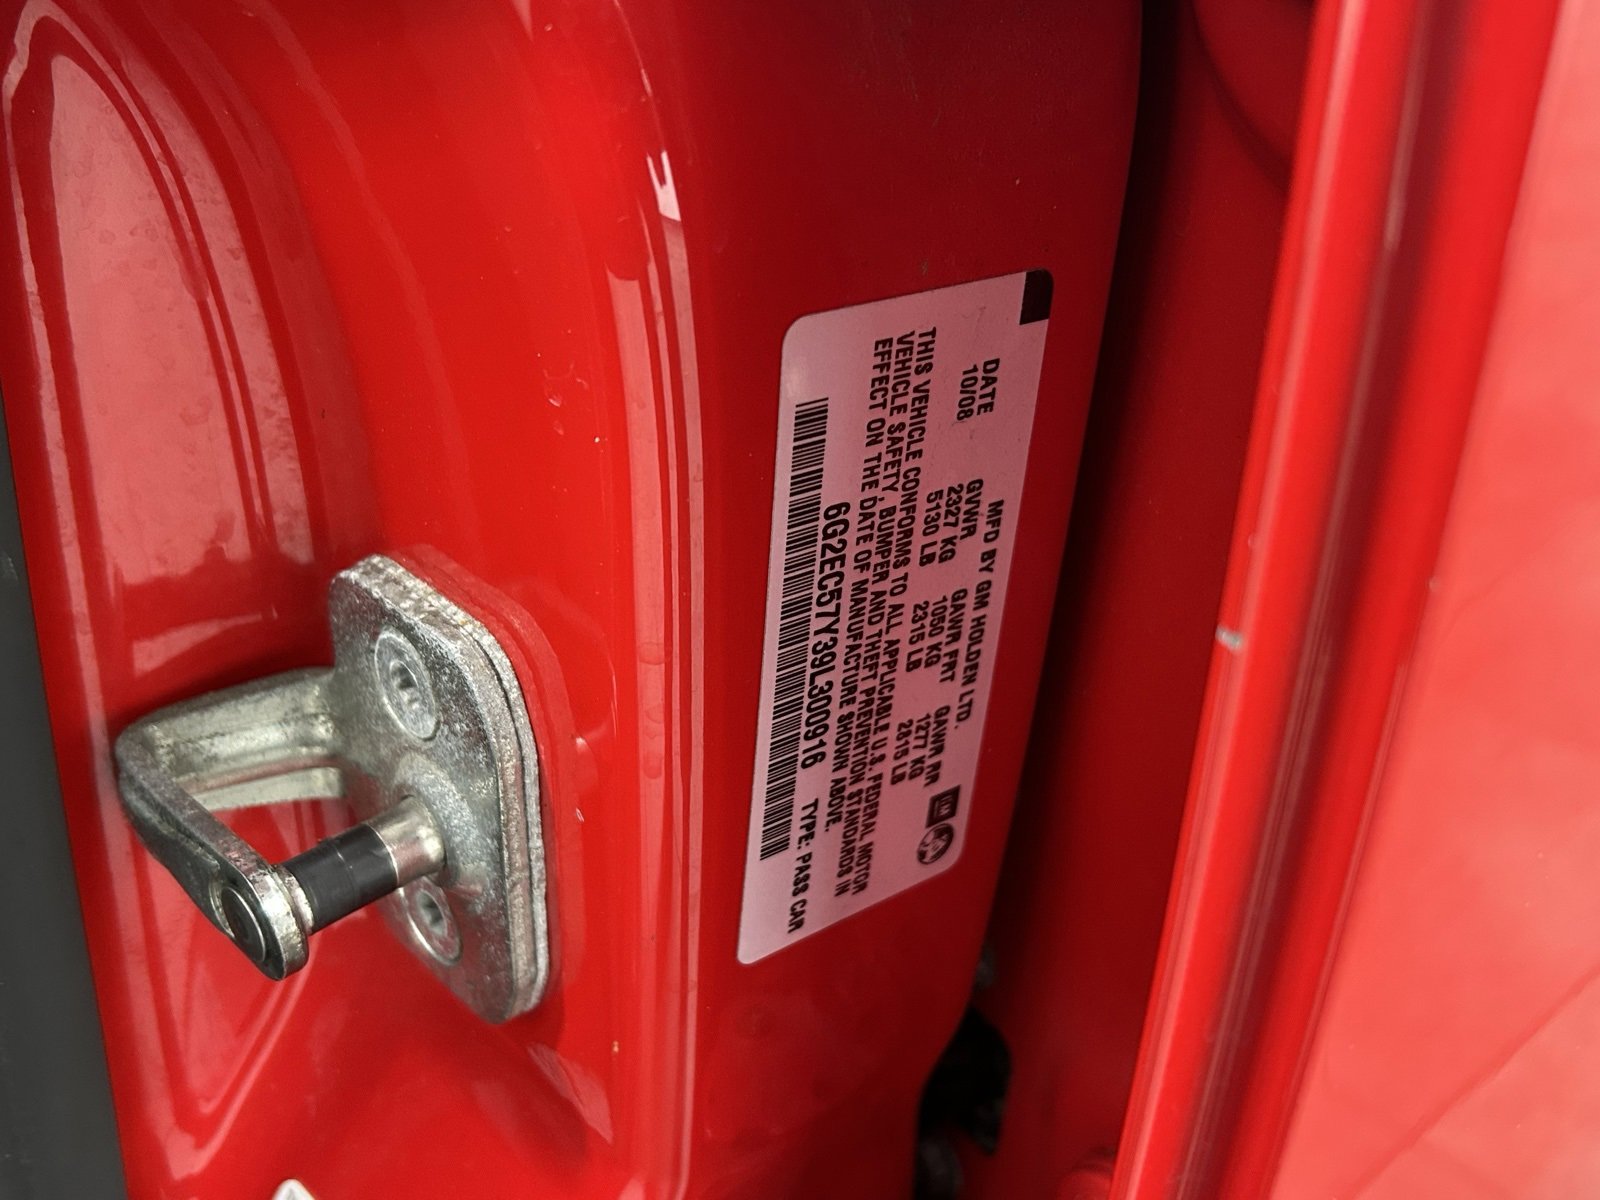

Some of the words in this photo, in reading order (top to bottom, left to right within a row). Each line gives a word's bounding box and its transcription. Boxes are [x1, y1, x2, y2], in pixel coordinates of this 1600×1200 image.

[868, 338, 893, 409] EFFECT
[889, 331, 915, 416] VEHICLE
[913, 327, 936, 375] THIS
[956, 365, 978, 420] 10/08
[976, 358, 1000, 415] DATE
[865, 418, 885, 447] ON
[904, 380, 930, 462] VEHICLE
[860, 452, 882, 492] THE
[876, 422, 906, 501] SAFETY,
[855, 496, 877, 546] DATE
[892, 467, 921, 569] CONFORMS
[921, 489, 944, 536] 5130
[942, 484, 964, 527] 2327
[959, 479, 983, 540] GVWR
[983, 500, 1004, 543] MFD
[853, 550, 872, 573] OF
[871, 506, 896, 584] BUMPER
[918, 541, 937, 567] LB
[938, 535, 958, 563] KG
[978, 549, 996, 572] BY
[888, 573, 908, 596] TO
[972, 580, 992, 611] GM
[867, 590, 887, 625] AND
[884, 604, 904, 635] ALL
[908, 601, 929, 645] 2315
[927, 596, 948, 637] 1050
[944, 589, 968, 646] GAWR
[800, 502, 851, 769] 6G2EC57Y39L300916
[838, 579, 869, 709] MANUFACTURE
[860, 629, 883, 681] THEFT
[923, 642, 942, 668] KG
[961, 615, 986, 686] HOLDEN
[905, 648, 923, 672] LB
[939, 649, 959, 682] FRT
[872, 639, 900, 735] APPLICABLE
[954, 689, 974, 728] LTD.
[831, 711, 855, 772] SHOWN
[848, 686, 876, 786] PREVENTION
[867, 737, 887, 771] U.S.
[893, 719, 913, 760] 2815
[912, 714, 931, 749] 1277
[927, 706, 950, 758] GAWR
[890, 762, 907, 785] LB
[907, 755, 926, 780] KG
[924, 761, 941, 787] RR
[797, 798, 819, 849] TYPE:
[824, 777, 847, 832] ABOVE.
[858, 773, 883, 841] FEDERAL
[836, 789, 864, 878] STANDARDS
[791, 852, 812, 897] PASS
[834, 880, 851, 896] IN
[852, 842, 873, 895] MOTOR
[787, 899, 807, 933] CAR
